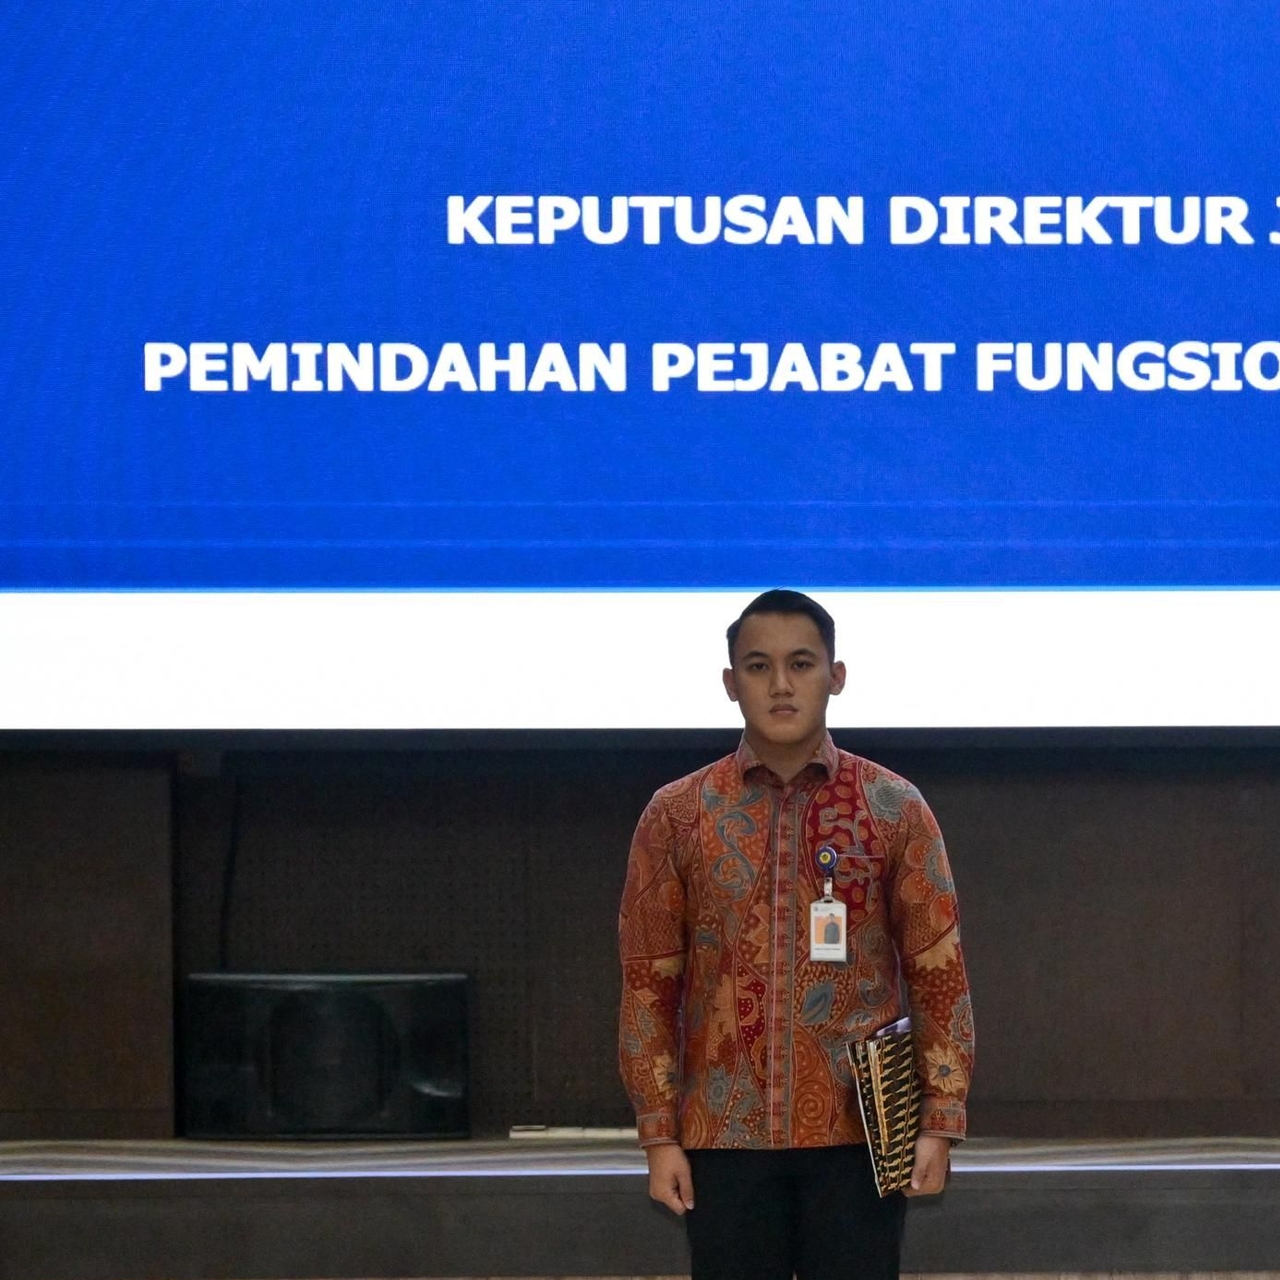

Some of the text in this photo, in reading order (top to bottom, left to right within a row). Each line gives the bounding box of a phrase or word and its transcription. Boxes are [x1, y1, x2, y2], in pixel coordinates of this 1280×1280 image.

[447, 194, 864, 246] KEPUTUSAN
[889, 196, 1255, 246] DIREKTUR
[144, 342, 627, 392] PEMINDAHAN
[652, 342, 956, 392] PEJABAT
